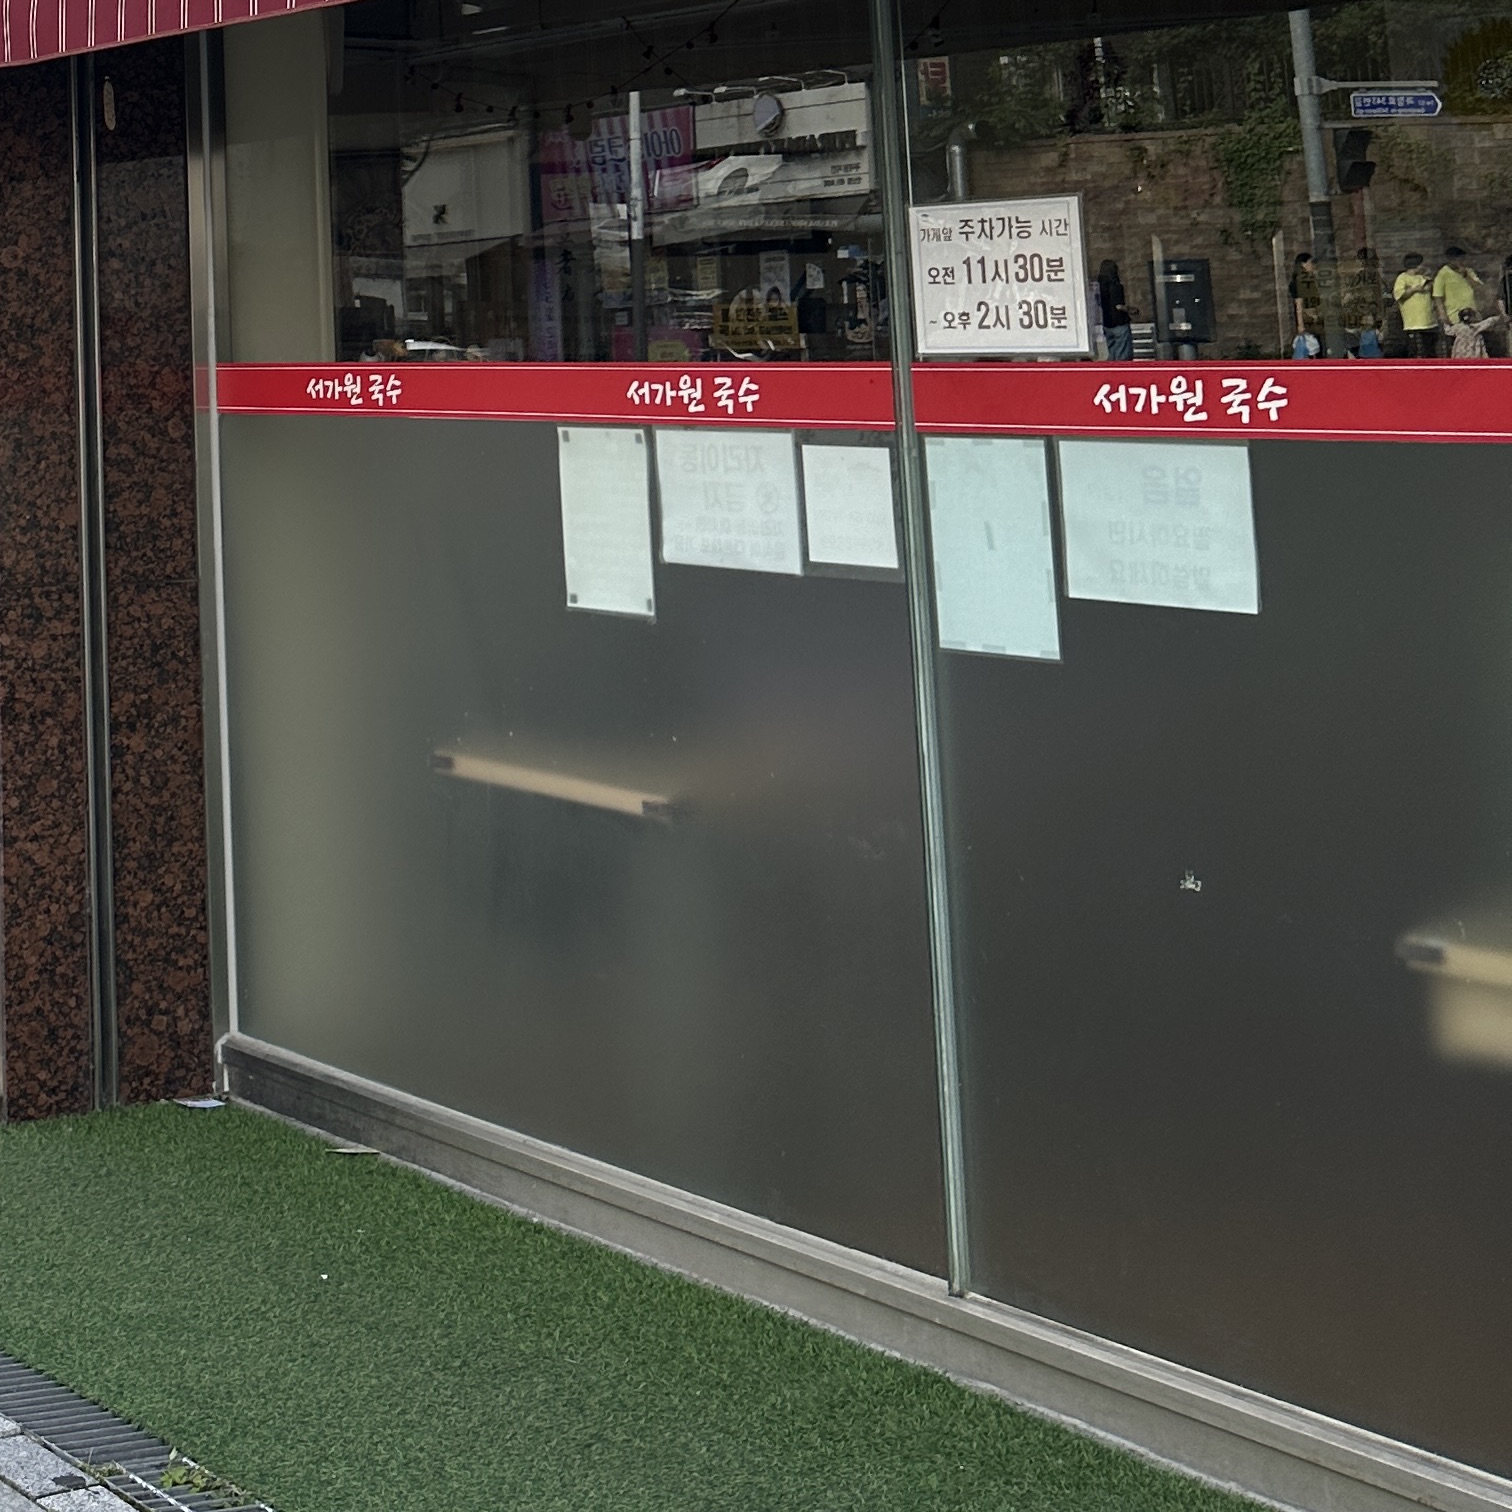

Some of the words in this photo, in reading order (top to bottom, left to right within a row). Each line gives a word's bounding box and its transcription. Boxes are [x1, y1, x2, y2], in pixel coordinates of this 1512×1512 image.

[920, 226, 953, 243] 가게앞
[958, 216, 1033, 241] 주차가능
[1039, 218, 1070, 237] 시간
[928, 266, 955, 285] 오전
[962, 255, 1009, 285] 11시
[1013, 253, 1065, 283] 30분
[943, 311, 971, 330] 오후
[976, 301, 1011, 330] 2시
[1018, 299, 1068, 330] 30분
[306, 373, 363, 406] 서가원
[368, 374, 402, 407] 국수
[626, 374, 705, 413] 서가원
[713, 376, 760, 414] 국수
[1093, 375, 1208, 423] 서가원
[1220, 377, 1288, 424] 국수
